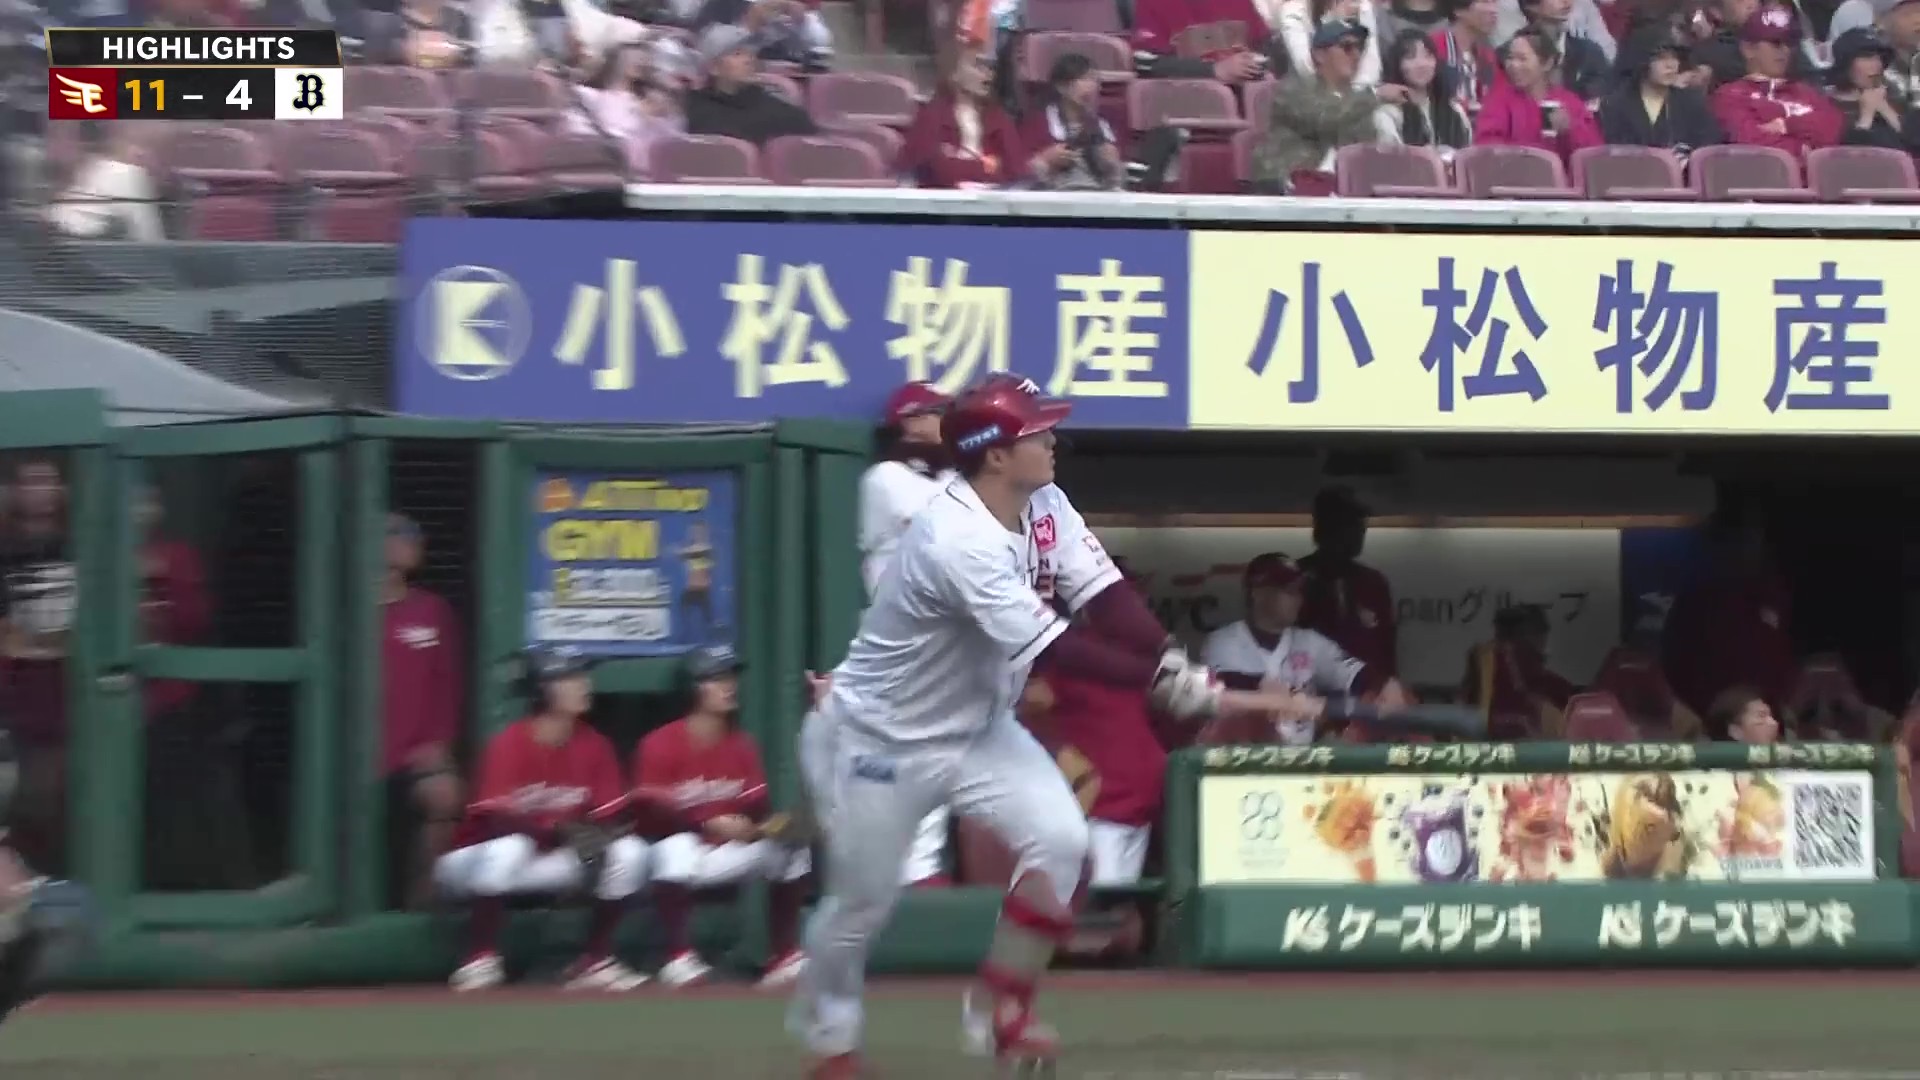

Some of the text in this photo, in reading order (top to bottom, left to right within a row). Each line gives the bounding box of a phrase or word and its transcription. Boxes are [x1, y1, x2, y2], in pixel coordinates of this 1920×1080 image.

[553, 253, 1168, 397] 小松物産
[1245, 256, 1891, 413] 小松物産
[1339, 903, 1542, 951] ケーズデンキ
[1654, 899, 1856, 949] ケーズデンキ
